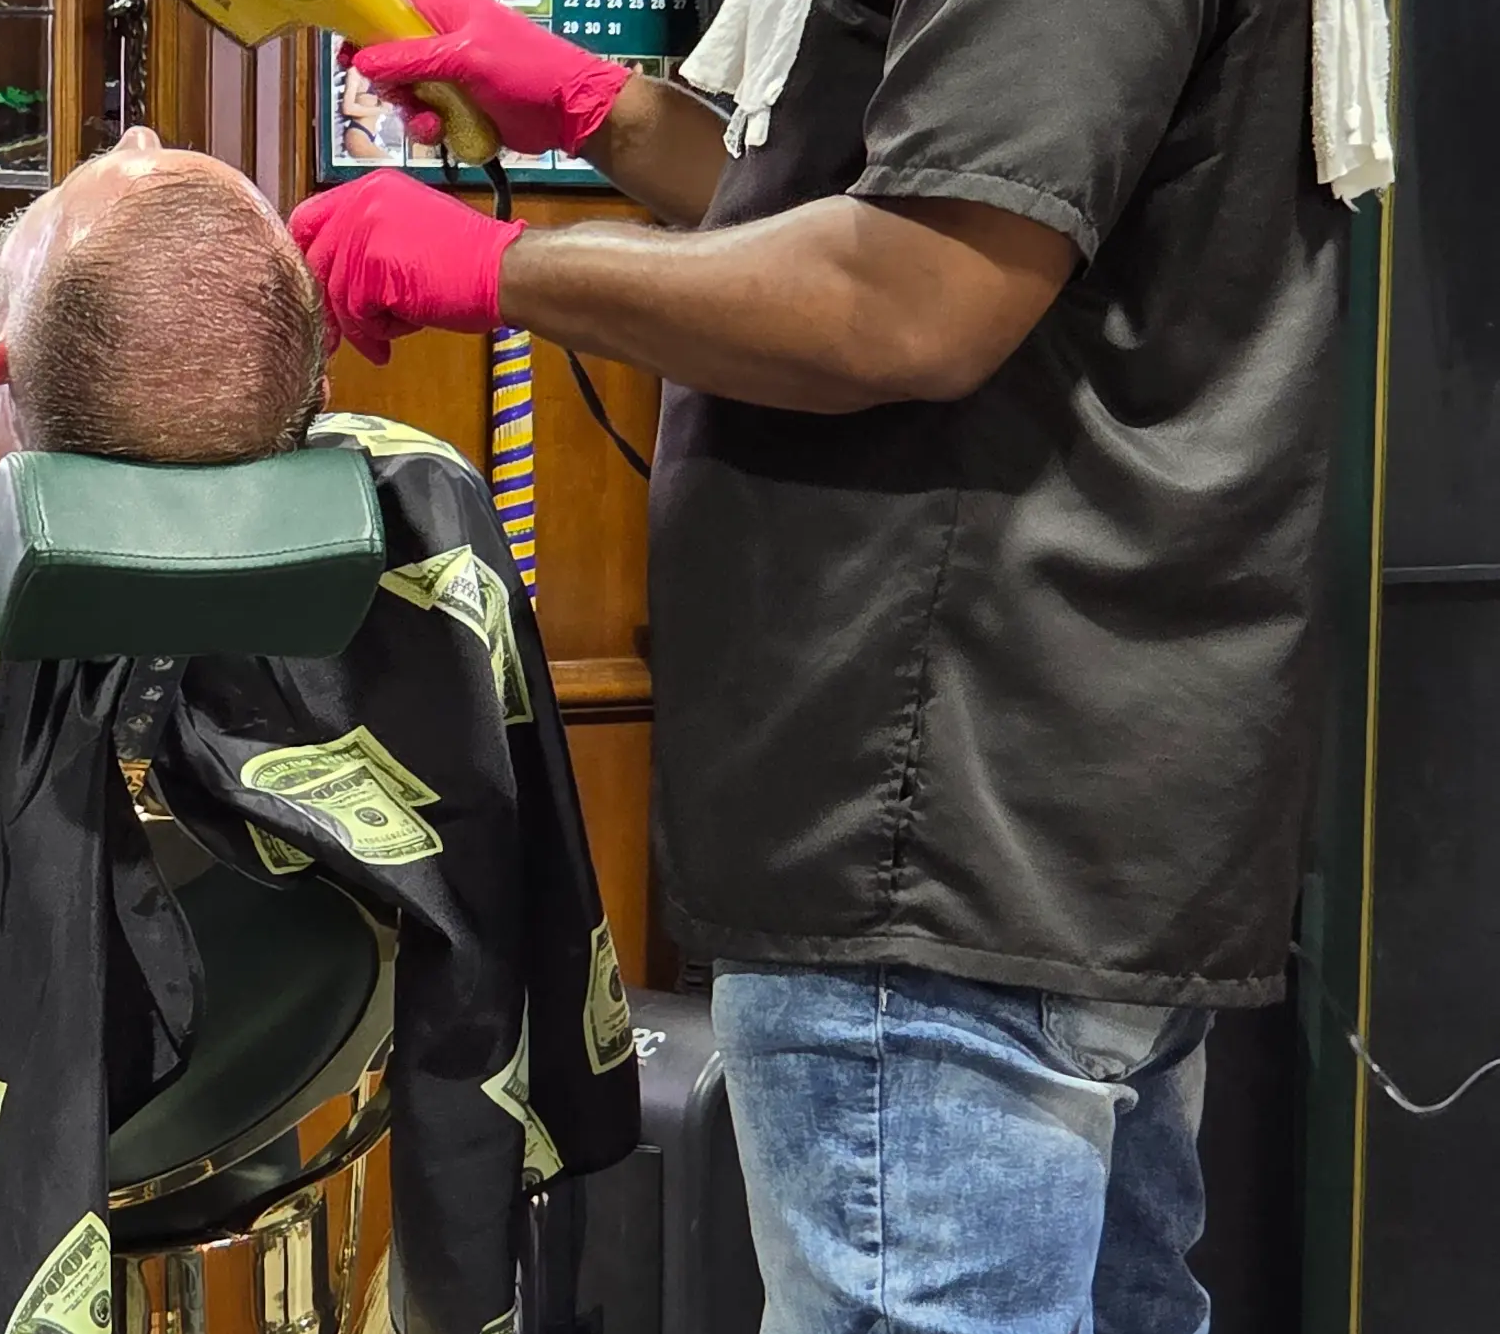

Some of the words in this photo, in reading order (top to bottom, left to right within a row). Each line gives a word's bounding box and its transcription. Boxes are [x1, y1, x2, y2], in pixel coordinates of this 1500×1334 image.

[562, 21, 579, 34] 29
[584, 21, 601, 35] 30
[607, 22, 621, 35] 31
